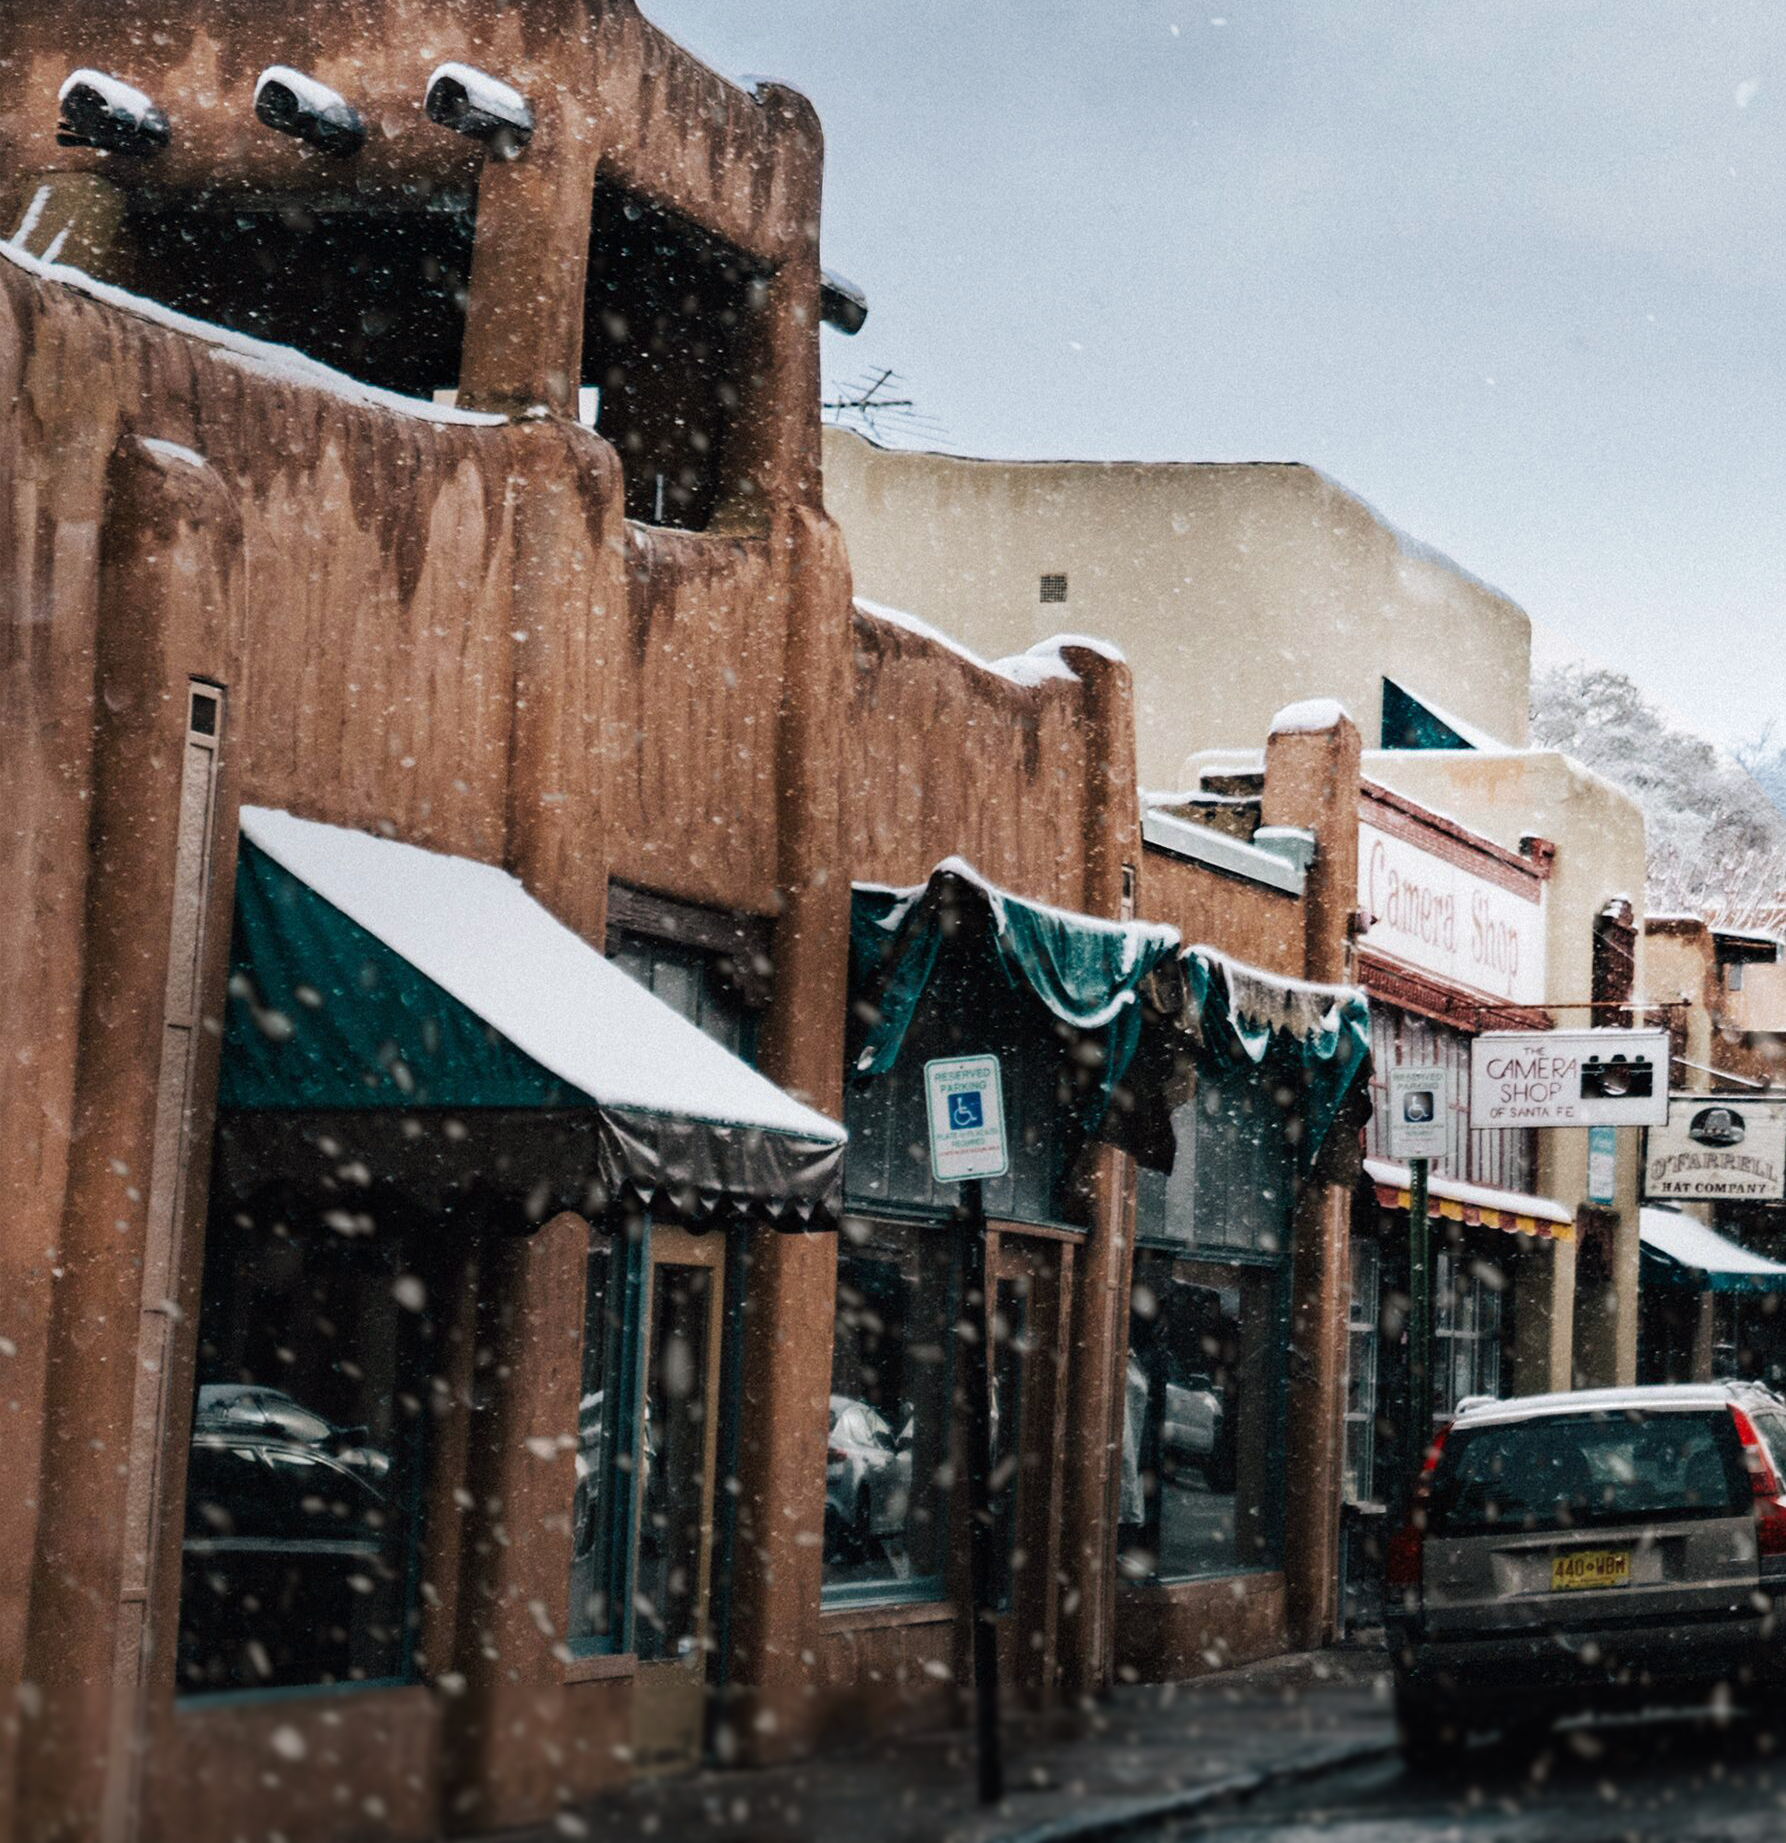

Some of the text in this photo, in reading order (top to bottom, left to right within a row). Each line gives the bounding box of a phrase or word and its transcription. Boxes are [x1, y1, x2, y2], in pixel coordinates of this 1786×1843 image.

[1370, 839, 1519, 996] Camera Shop
[1523, 1046, 1545, 1056] THE
[934, 1067, 991, 1081] RESERVED
[1486, 1057, 1578, 1080] CAMERA
[939, 1080, 988, 1092] PARKING
[1500, 1082, 1562, 1104] SHOP
[1490, 1106, 1575, 1118] OF SANTA FE
[1650, 1152, 1778, 1181] O'FARRELL
[1662, 1181, 1767, 1194] HAT COMPANY
[1554, 1559, 1585, 1578] 440
